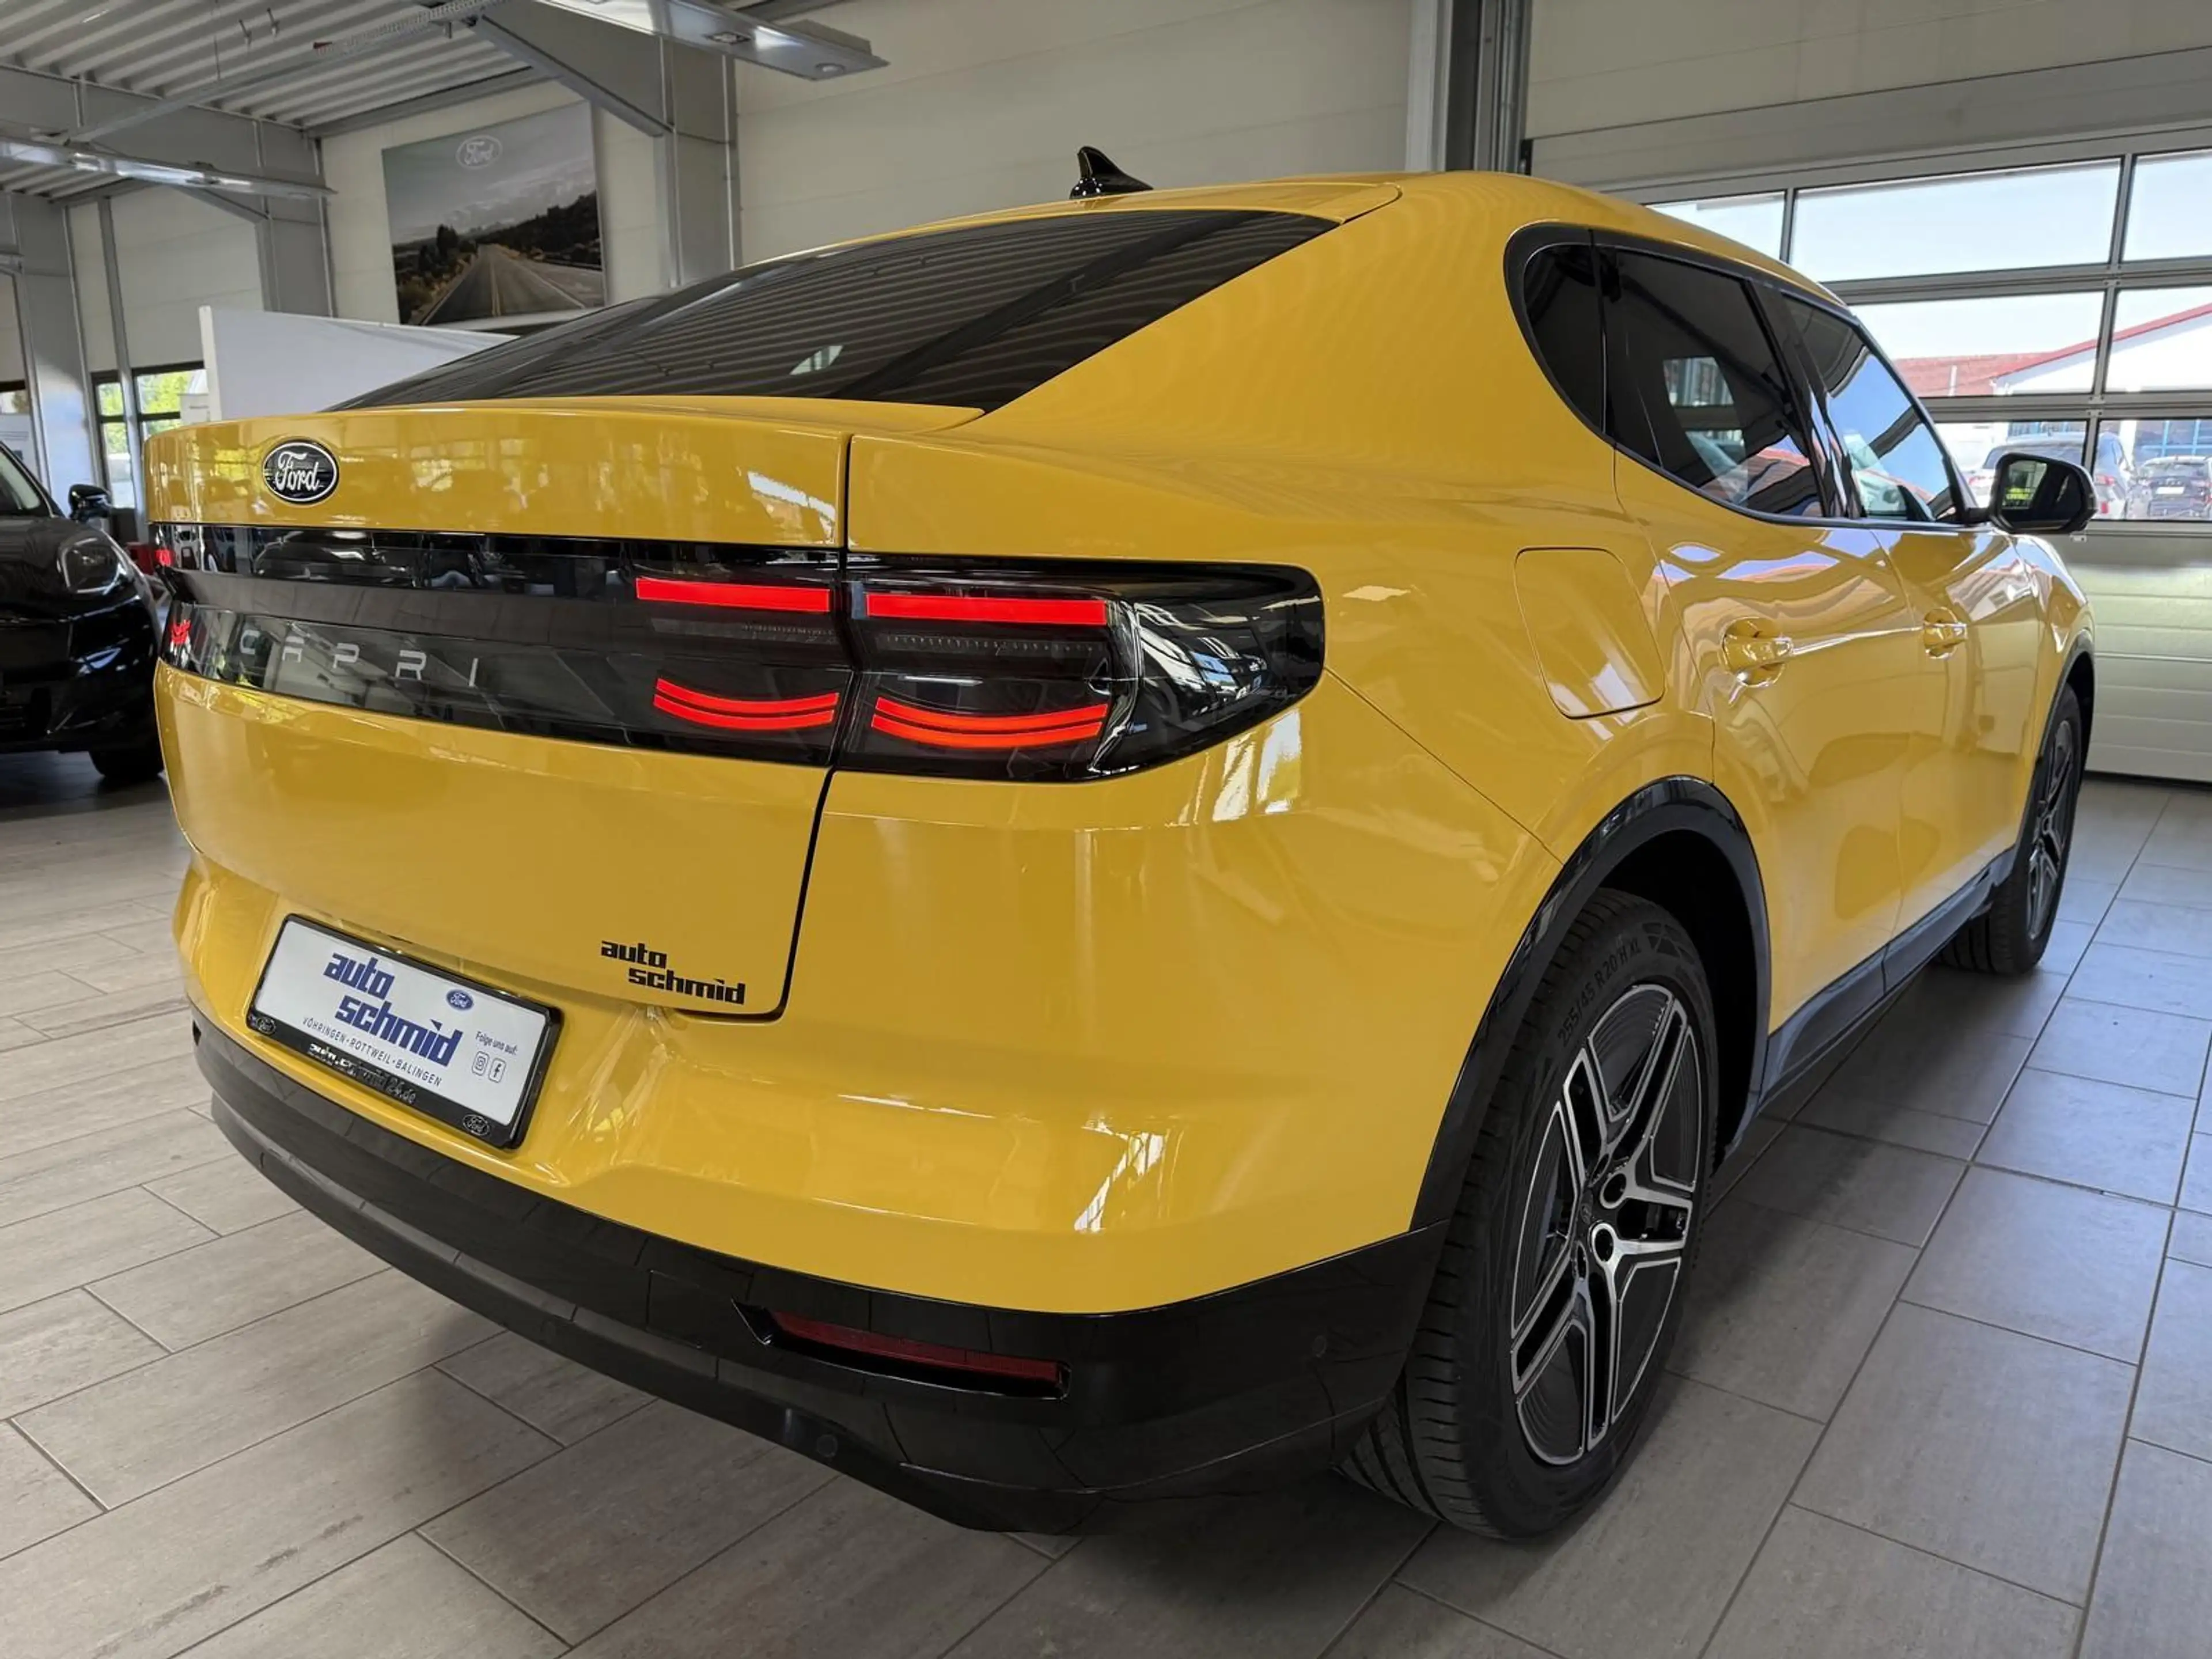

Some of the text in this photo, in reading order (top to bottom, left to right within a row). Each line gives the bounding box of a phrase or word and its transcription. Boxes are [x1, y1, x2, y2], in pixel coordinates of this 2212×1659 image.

[273, 451, 324, 491] Ford
[601, 940, 667, 969] auto
[323, 952, 395, 1000] auto
[628, 967, 745, 1005] schmid
[335, 995, 463, 1067] schmid
